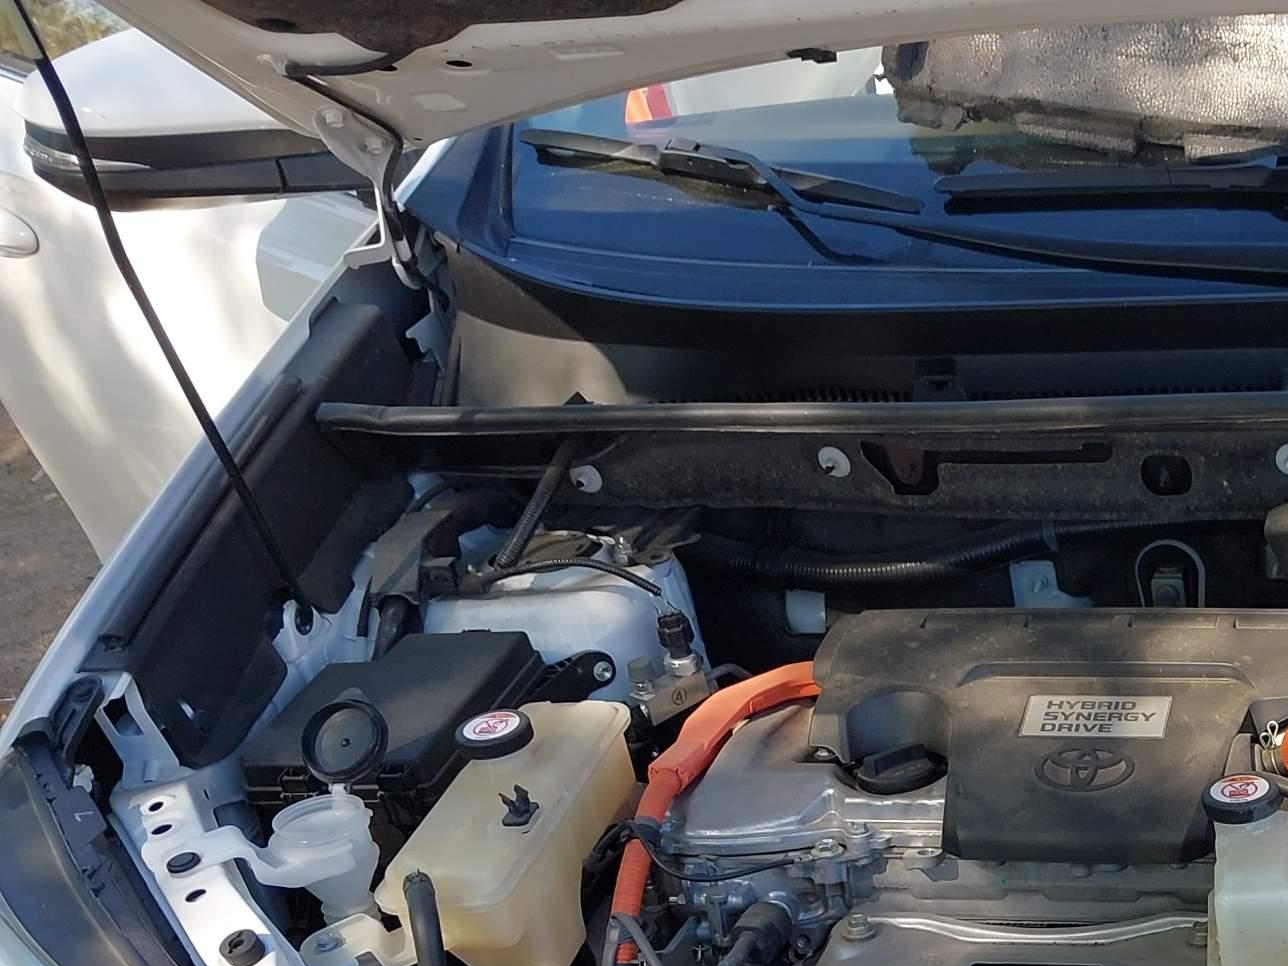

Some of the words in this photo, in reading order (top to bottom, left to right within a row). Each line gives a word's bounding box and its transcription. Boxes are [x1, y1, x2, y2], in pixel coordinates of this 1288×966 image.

[1046, 700, 1137, 711] HYBRID
[1043, 711, 1157, 722] SYNERGY
[1040, 723, 1113, 733] DRIVE
